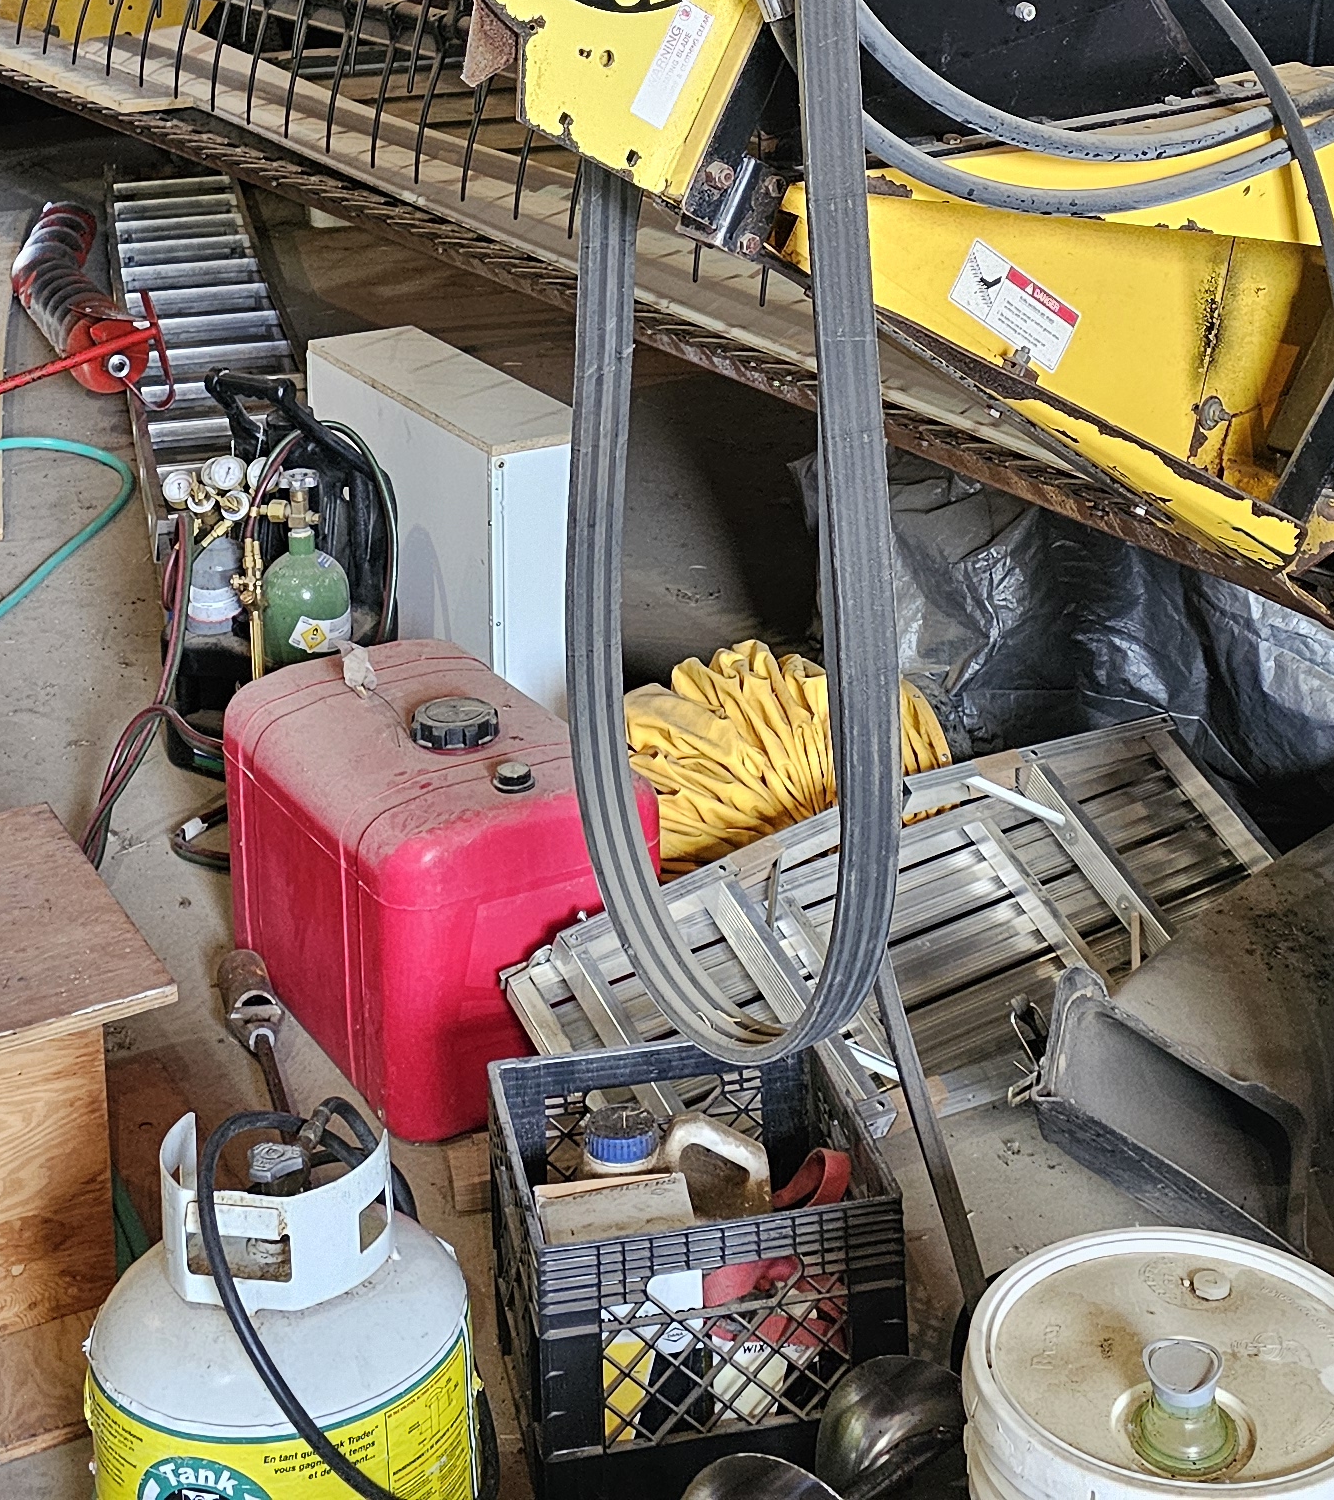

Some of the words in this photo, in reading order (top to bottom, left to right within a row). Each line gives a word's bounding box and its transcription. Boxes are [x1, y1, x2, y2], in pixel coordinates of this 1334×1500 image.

[696, 14, 711, 38] CLEAR
[676, 32, 693, 58] BLADE
[1033, 288, 1061, 313] DANGER
[742, 1343, 766, 1354] WIX
[263, 1455, 277, 1465] En
[279, 1451, 298, 1463] tant
[274, 1465, 296, 1475] vous
[349, 1440, 376, 1458] temps
[158, 1461, 239, 1498] Tank
